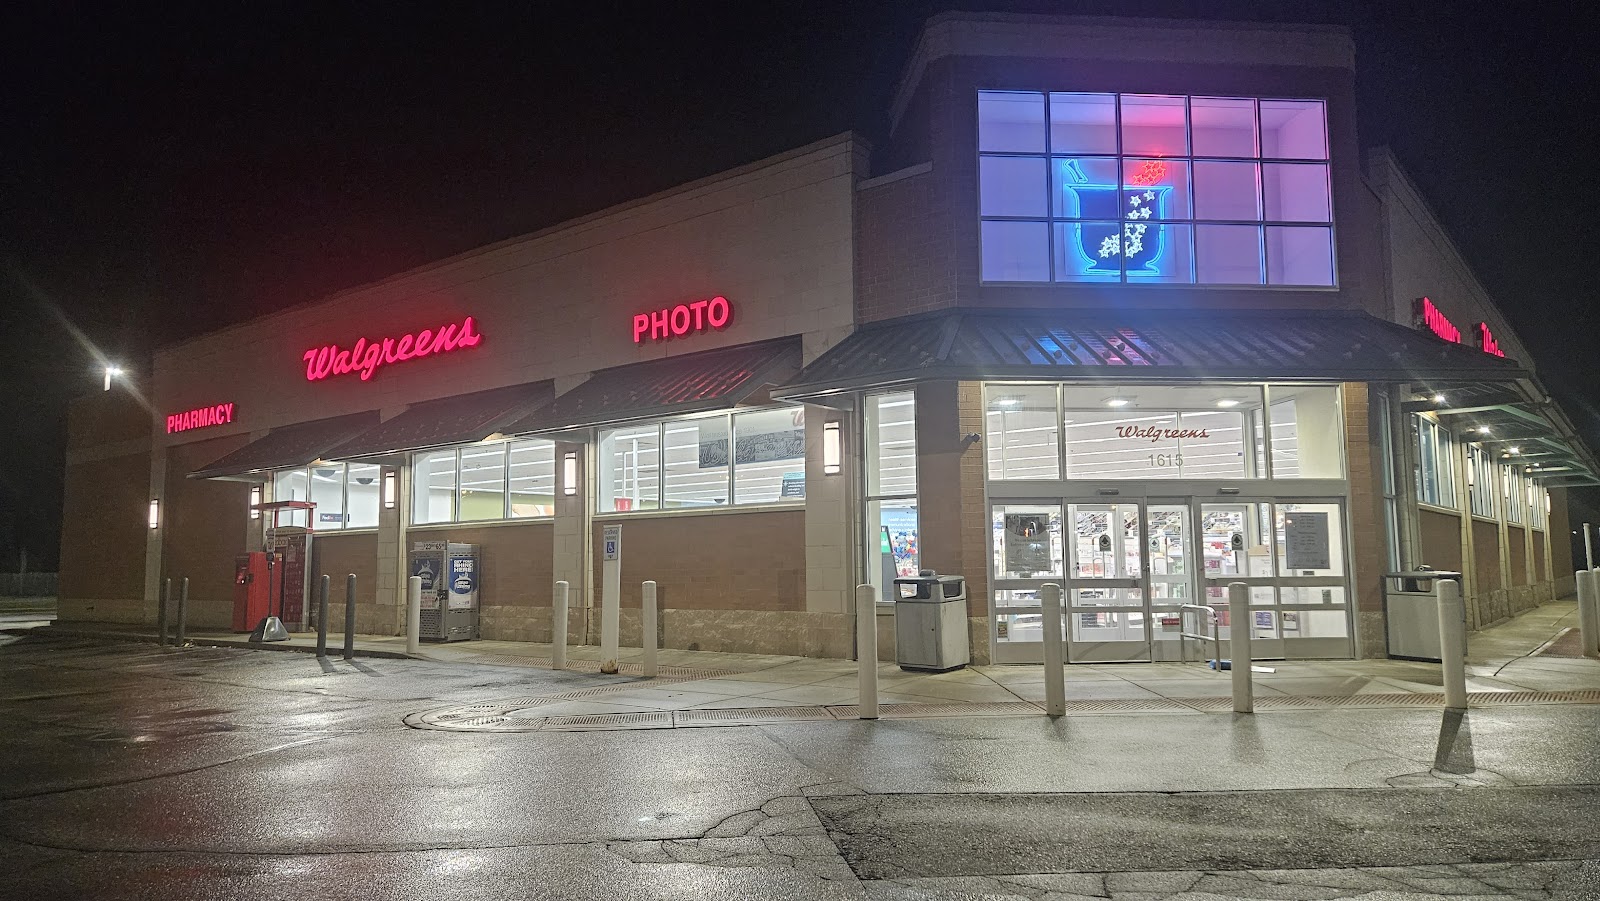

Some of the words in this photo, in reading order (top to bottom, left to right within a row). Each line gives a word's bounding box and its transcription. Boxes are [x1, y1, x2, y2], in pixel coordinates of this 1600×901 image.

[633, 296, 729, 343] PHOTO
[303, 316, 480, 381] Walgreens
[167, 402, 234, 434] PHARMACY
[1115, 425, 1210, 442] Walgreens
[1148, 453, 1184, 467] 1615
